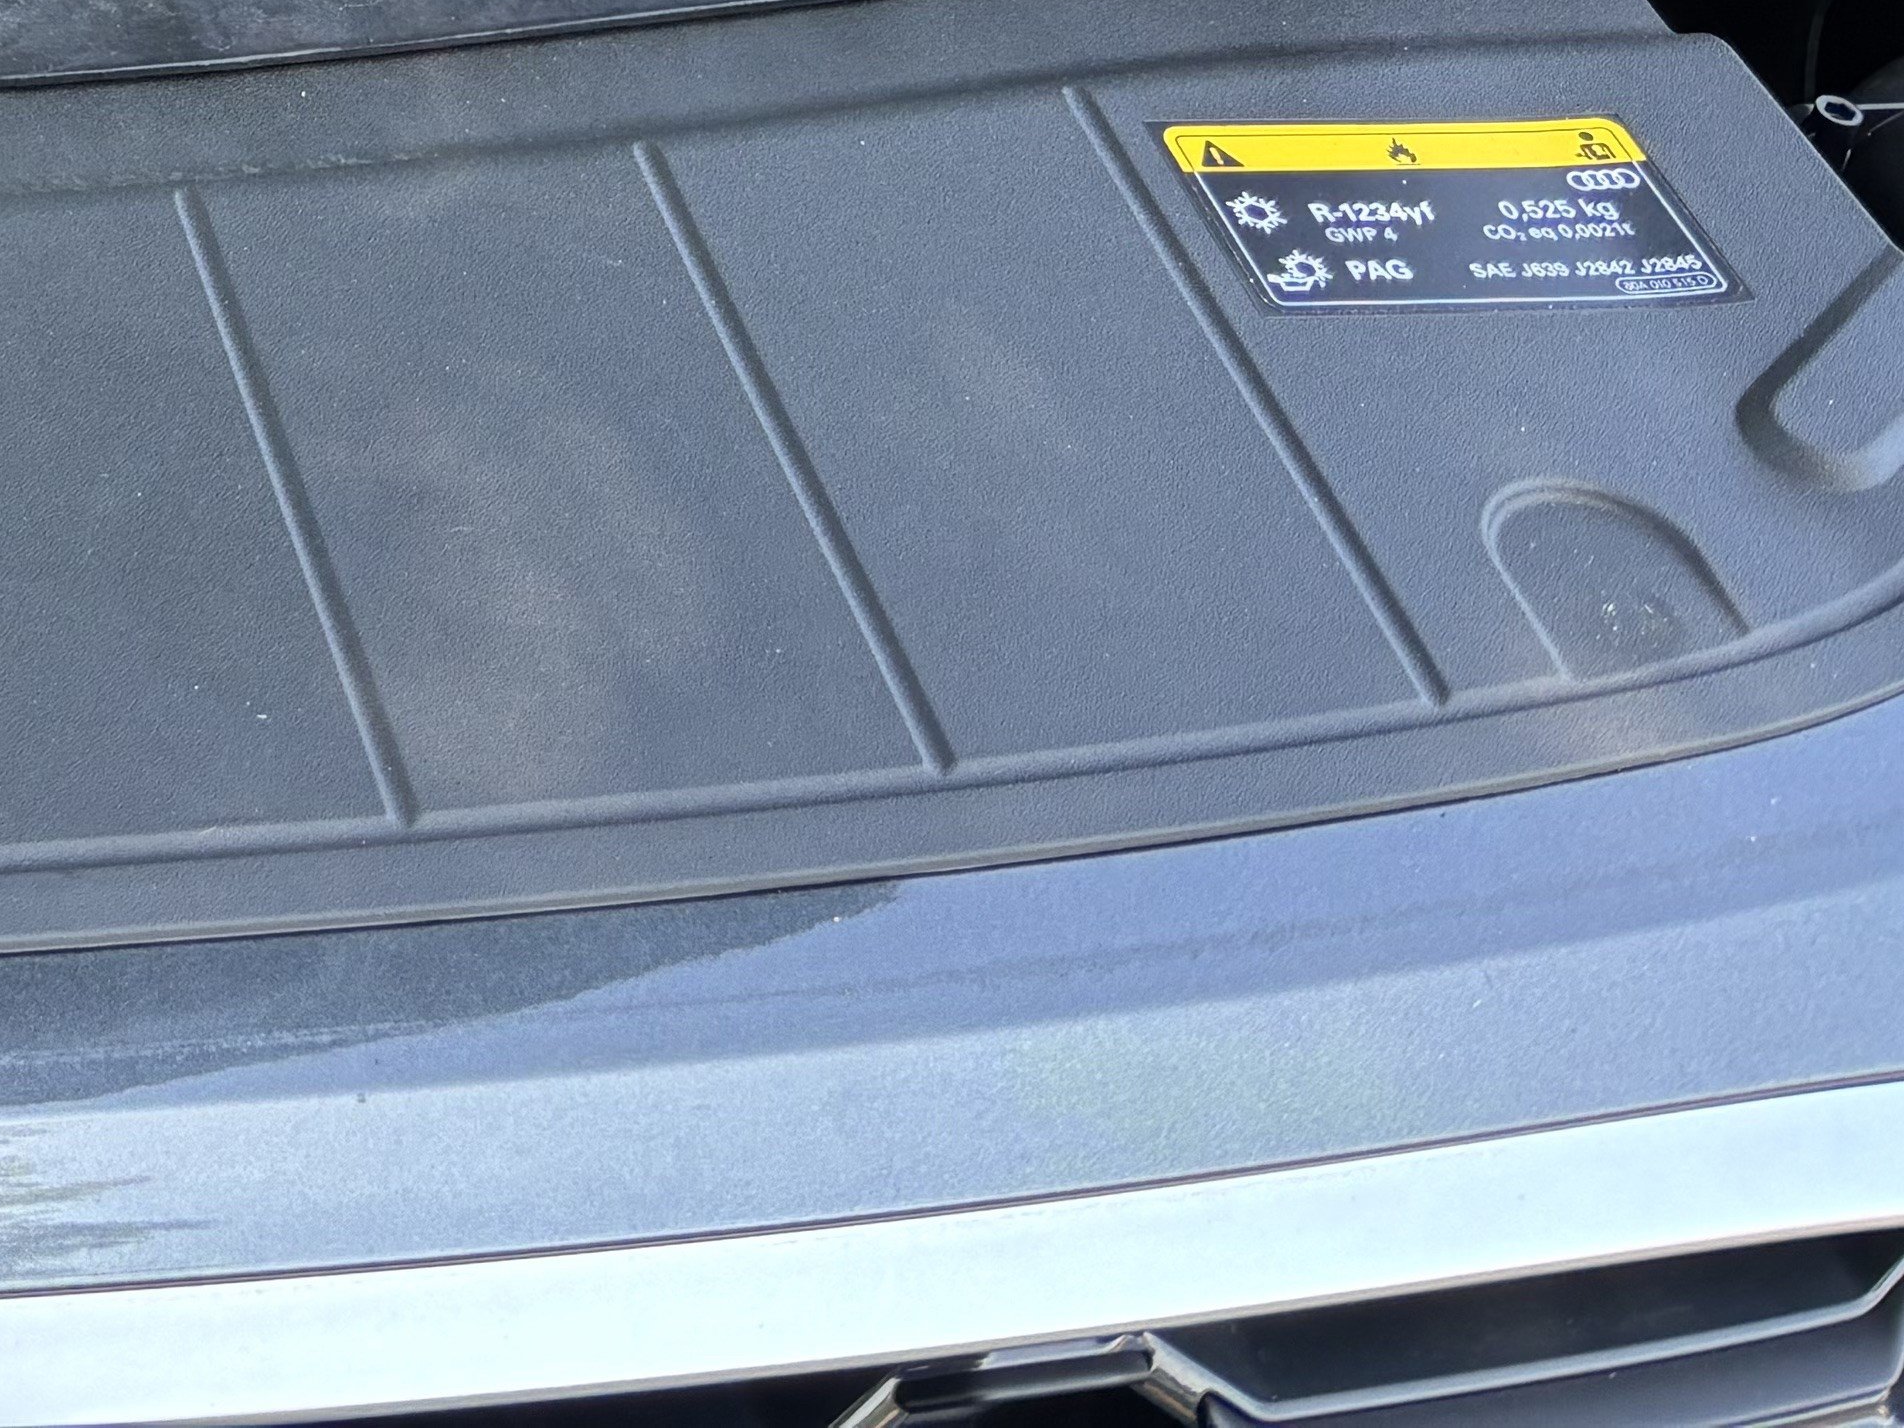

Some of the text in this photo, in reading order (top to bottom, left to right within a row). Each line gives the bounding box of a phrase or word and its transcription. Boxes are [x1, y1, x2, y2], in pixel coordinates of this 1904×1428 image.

[1307, 198, 1621, 226] R-1234yf 0,525 kg
[1325, 227, 1378, 242] GWP
[1384, 227, 1398, 242] 4
[1529, 225, 1558, 241] eq
[1345, 254, 1703, 281] PAG SAE J639 J2842 J2845
[1650, 279, 1671, 290] 010
